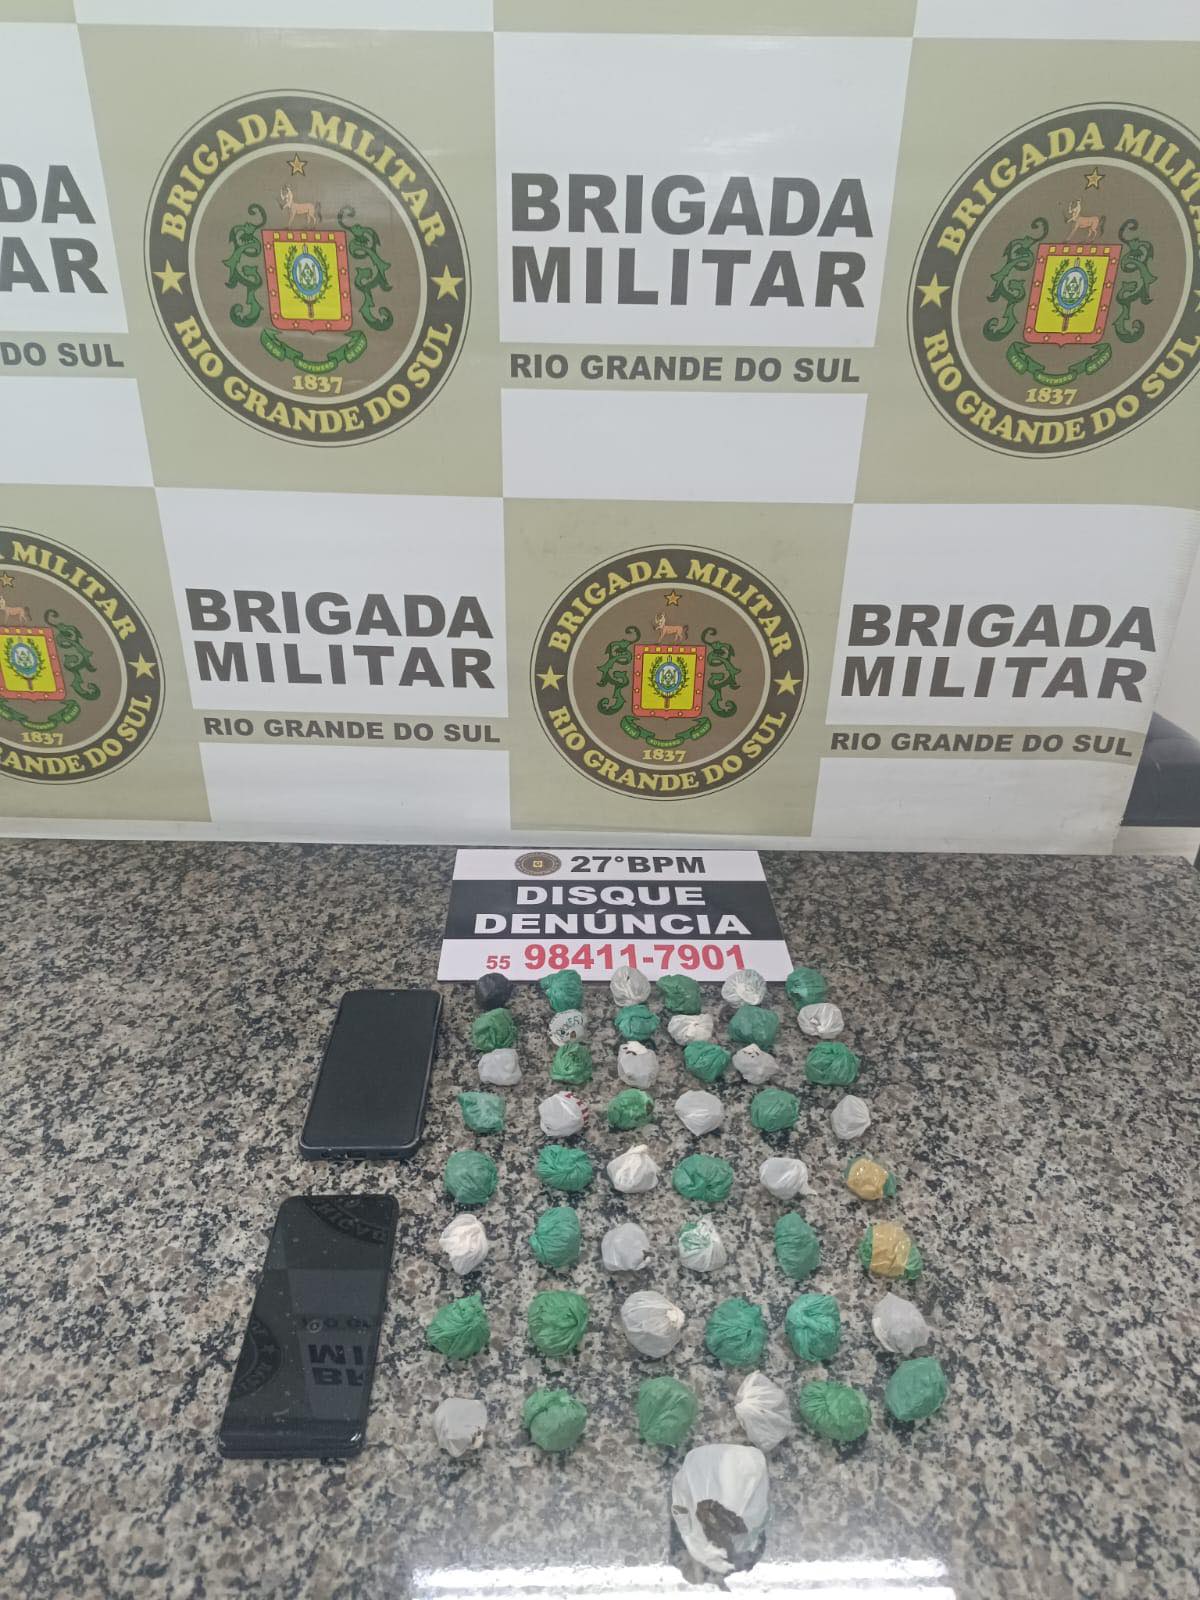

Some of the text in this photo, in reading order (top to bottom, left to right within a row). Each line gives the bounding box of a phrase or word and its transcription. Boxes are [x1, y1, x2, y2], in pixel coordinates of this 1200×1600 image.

[161, 109, 446, 247] BRIGADA MILITAR
[937, 122, 1200, 255] BRIGADA MILIT
[511, 173, 873, 237] BRIGADA
[512, 246, 866, 308] MILITAR
[0, 342, 124, 367] DO SUL
[174, 316, 224, 377] RIO
[225, 376, 364, 434] GRANDE
[366, 385, 410, 424] DO
[407, 322, 453, 388] SUL
[510, 354, 860, 383] RIO GRANDE DO SUL
[292, 375, 343, 394] 1837
[924, 329, 1200, 445] RIO GRANDE DO SUL
[1025, 387, 1078, 405] 1837
[12, 541, 137, 640] MILITAR
[185, 588, 494, 639] BRIGADA
[548, 558, 792, 657] BRIGADA MILITAR
[848, 604, 1156, 652] BRIGADA
[194, 640, 495, 689] MILITAR
[841, 656, 1147, 703] MILITAR
[0, 695, 152, 775] ANDE DO SUL
[21, 732, 64, 746] 1837
[204, 717, 500, 743] RIO GRANDE DO SUL
[548, 706, 787, 791] RIO GRANDE DO SUL
[830, 732, 1133, 757] RIO GRANDE DO SUL
[642, 748, 687, 763] 1837
[570, 855, 706, 874] 27°BPM
[516, 886, 706, 907] DISQUE
[474, 909, 752, 935] DENÚNCIA
[486, 944, 745, 970] 55 98411-7901
